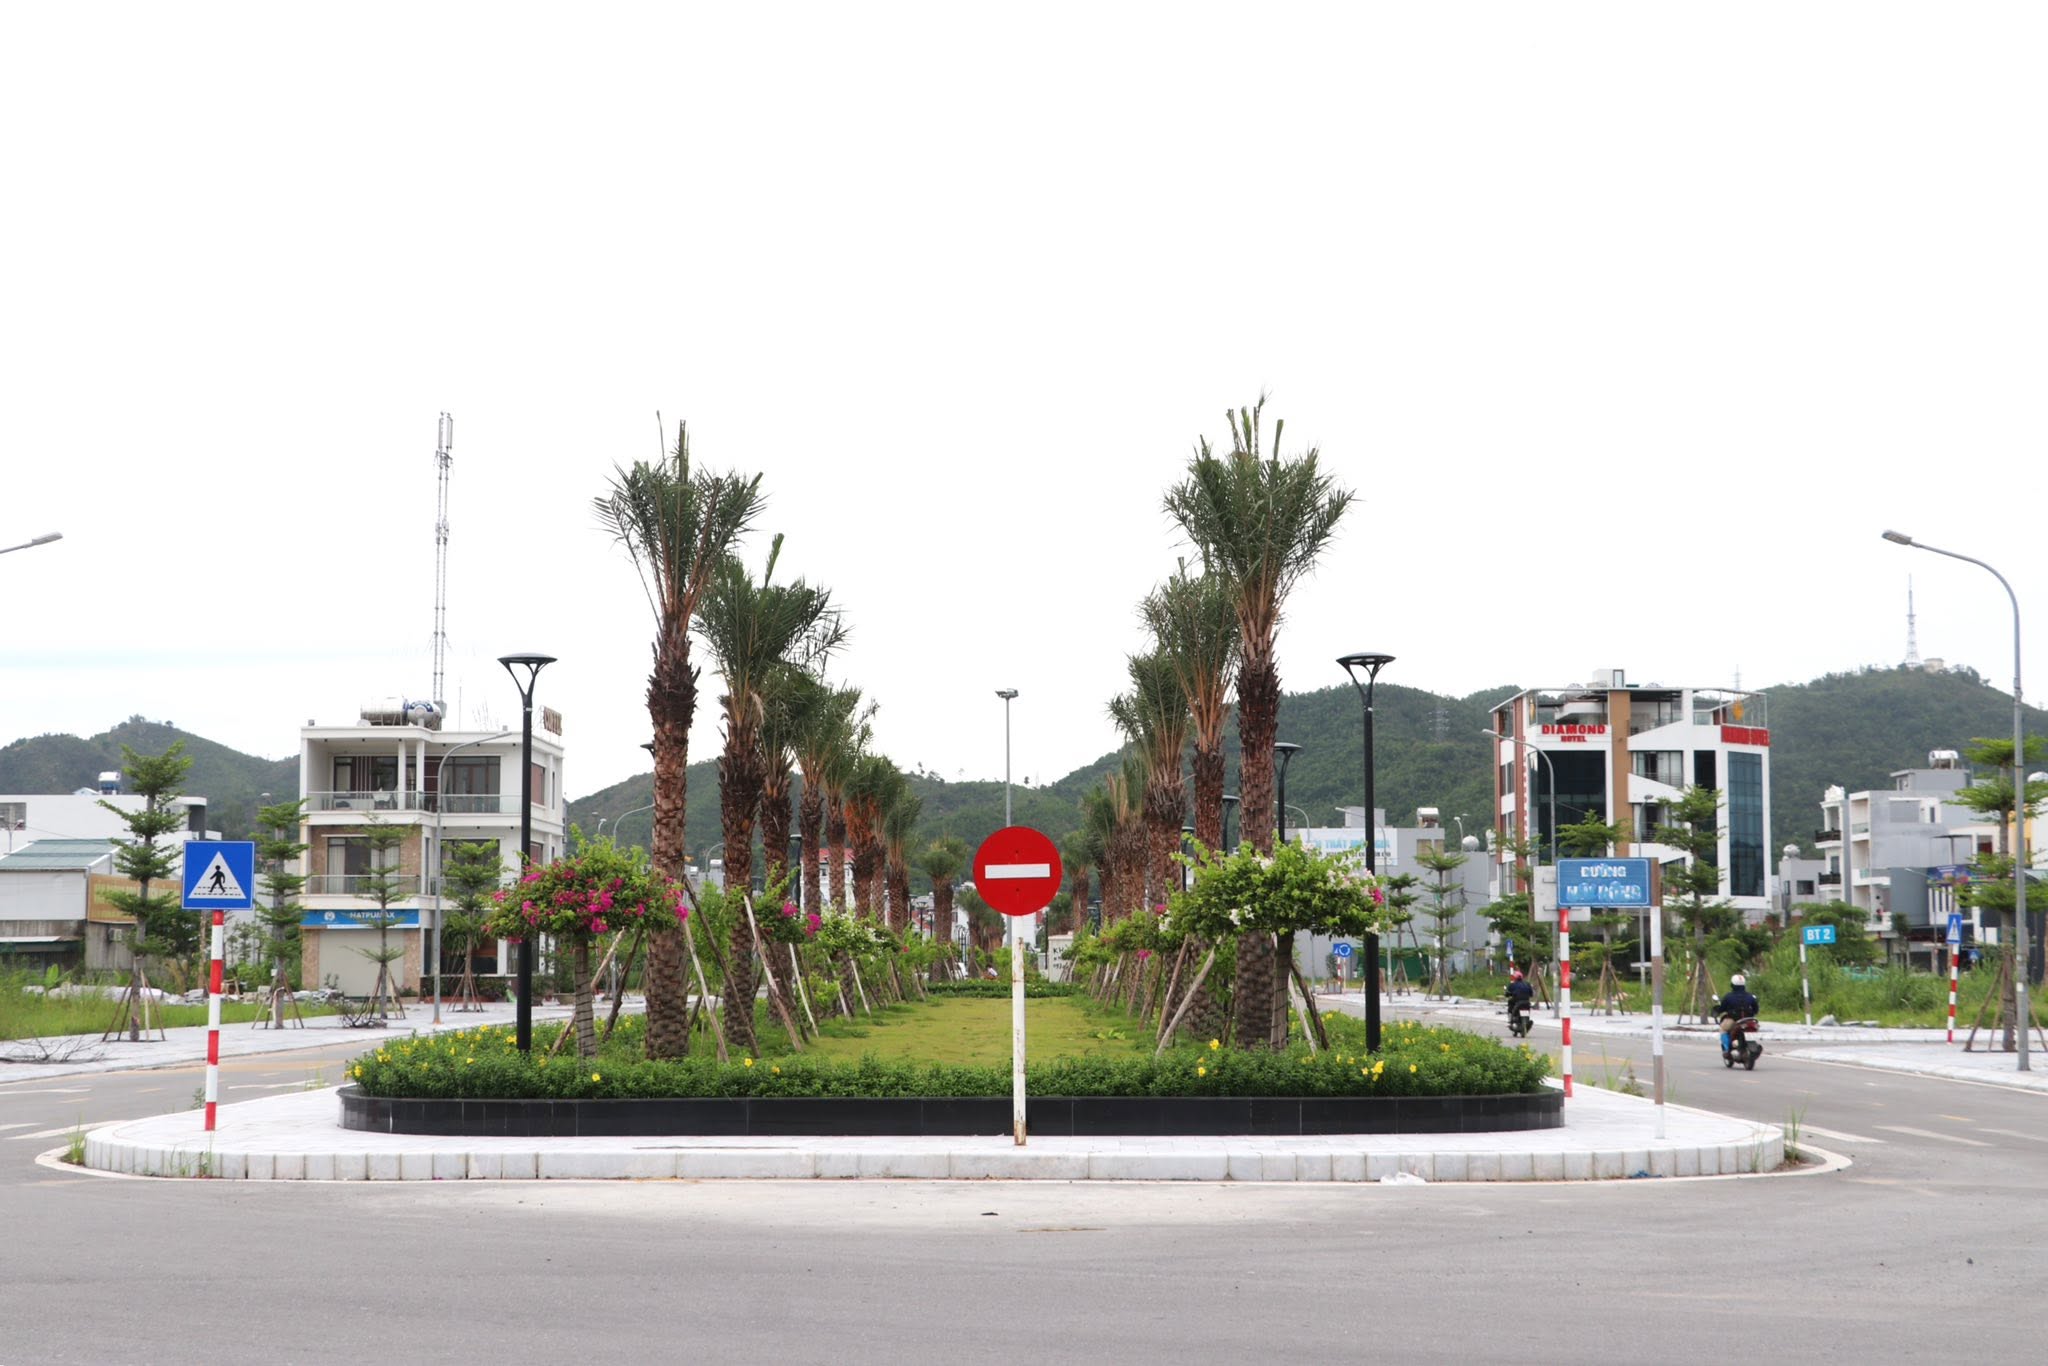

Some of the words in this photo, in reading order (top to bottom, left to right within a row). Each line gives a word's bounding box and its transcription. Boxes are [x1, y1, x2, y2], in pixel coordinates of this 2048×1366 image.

[1542, 724, 1605, 734] DIAMOND
[1807, 929, 1821, 941] BT
[1823, 927, 1831, 940] 2
